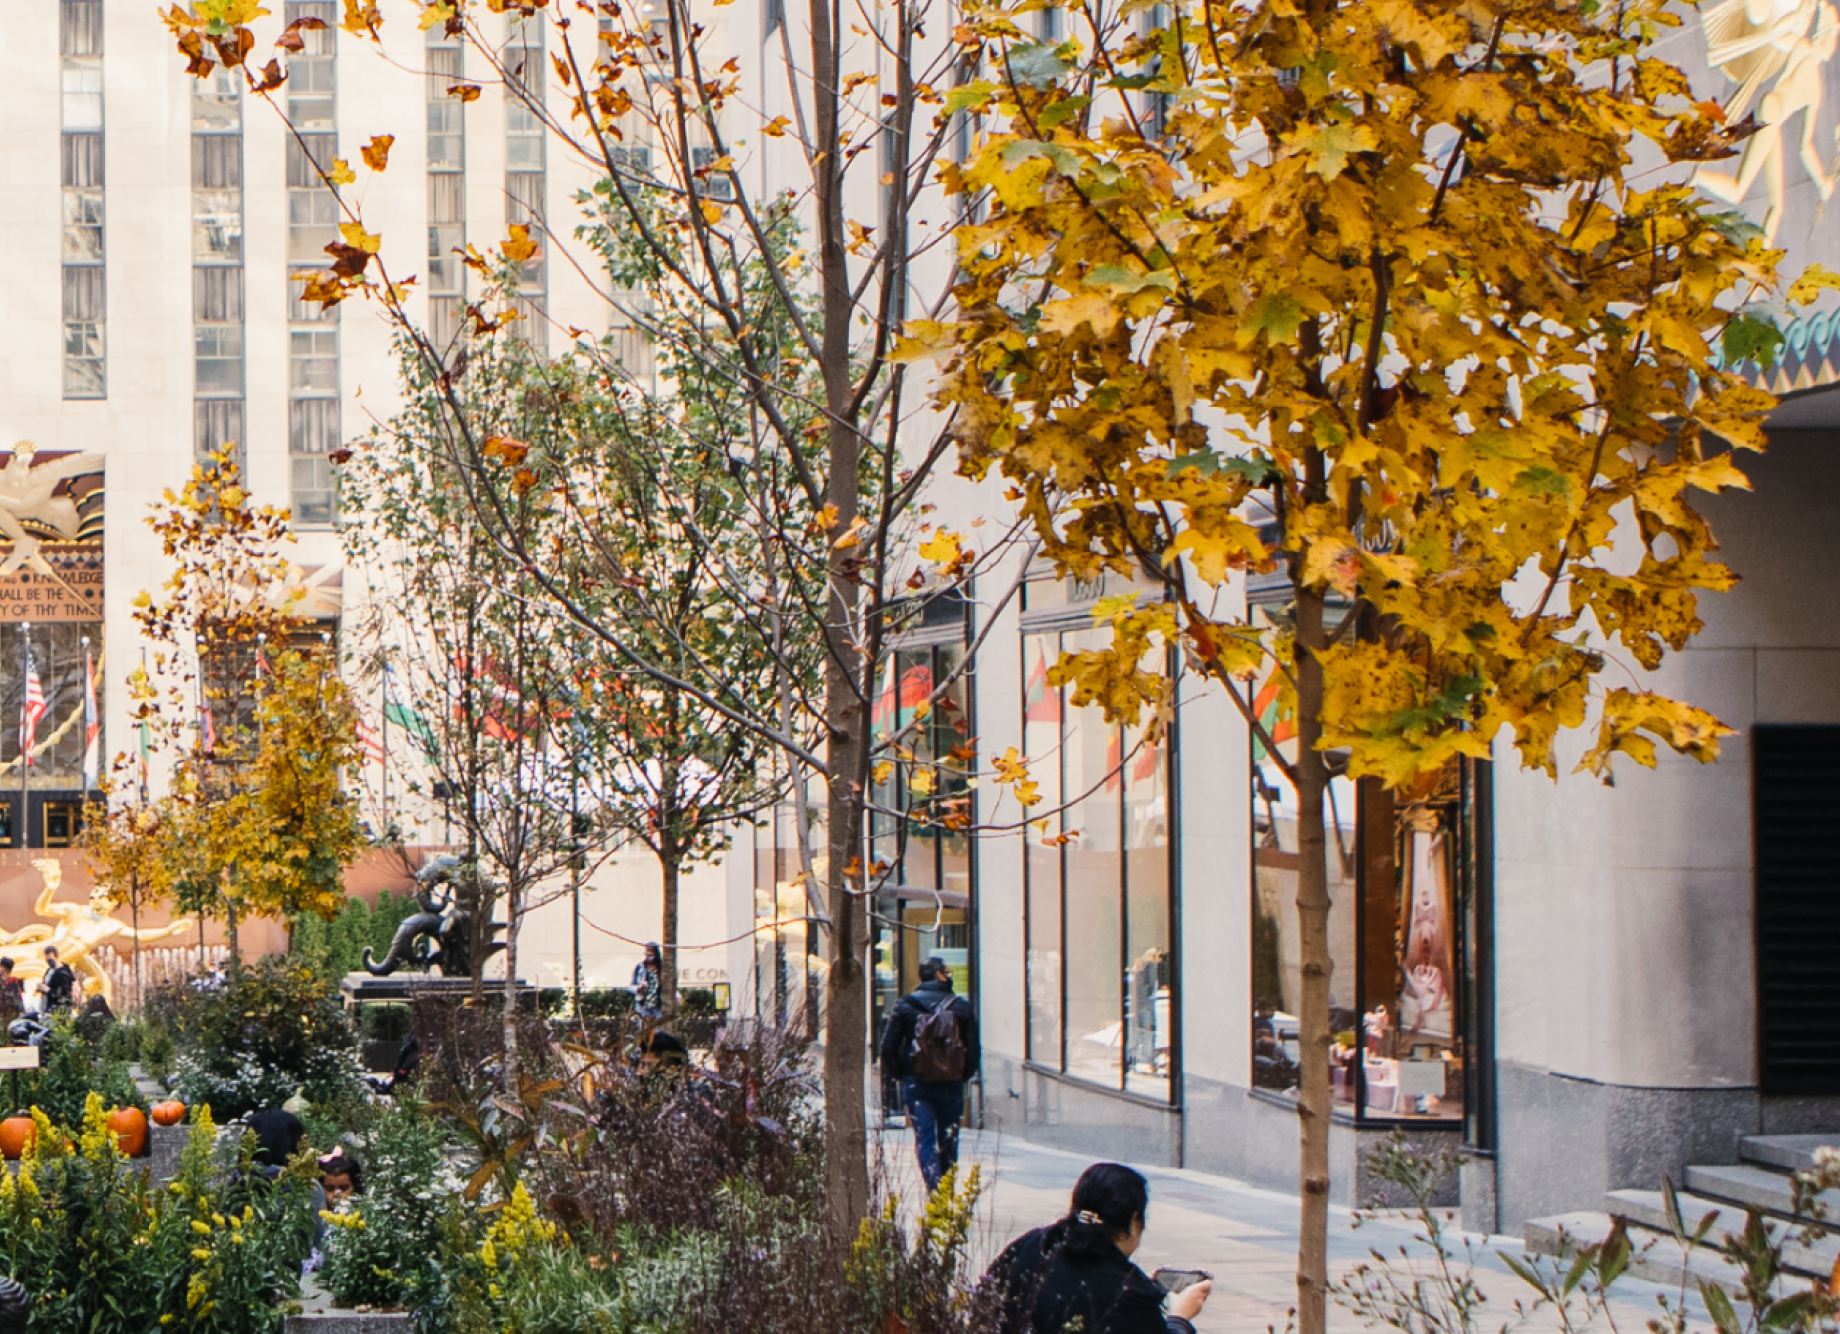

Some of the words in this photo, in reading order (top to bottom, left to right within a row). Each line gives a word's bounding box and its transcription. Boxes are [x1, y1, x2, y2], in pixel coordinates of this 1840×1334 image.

[26, 588, 40, 600] BE
[45, 587, 64, 600] THE
[11, 604, 30, 616] OF
[33, 604, 58, 616] THY
